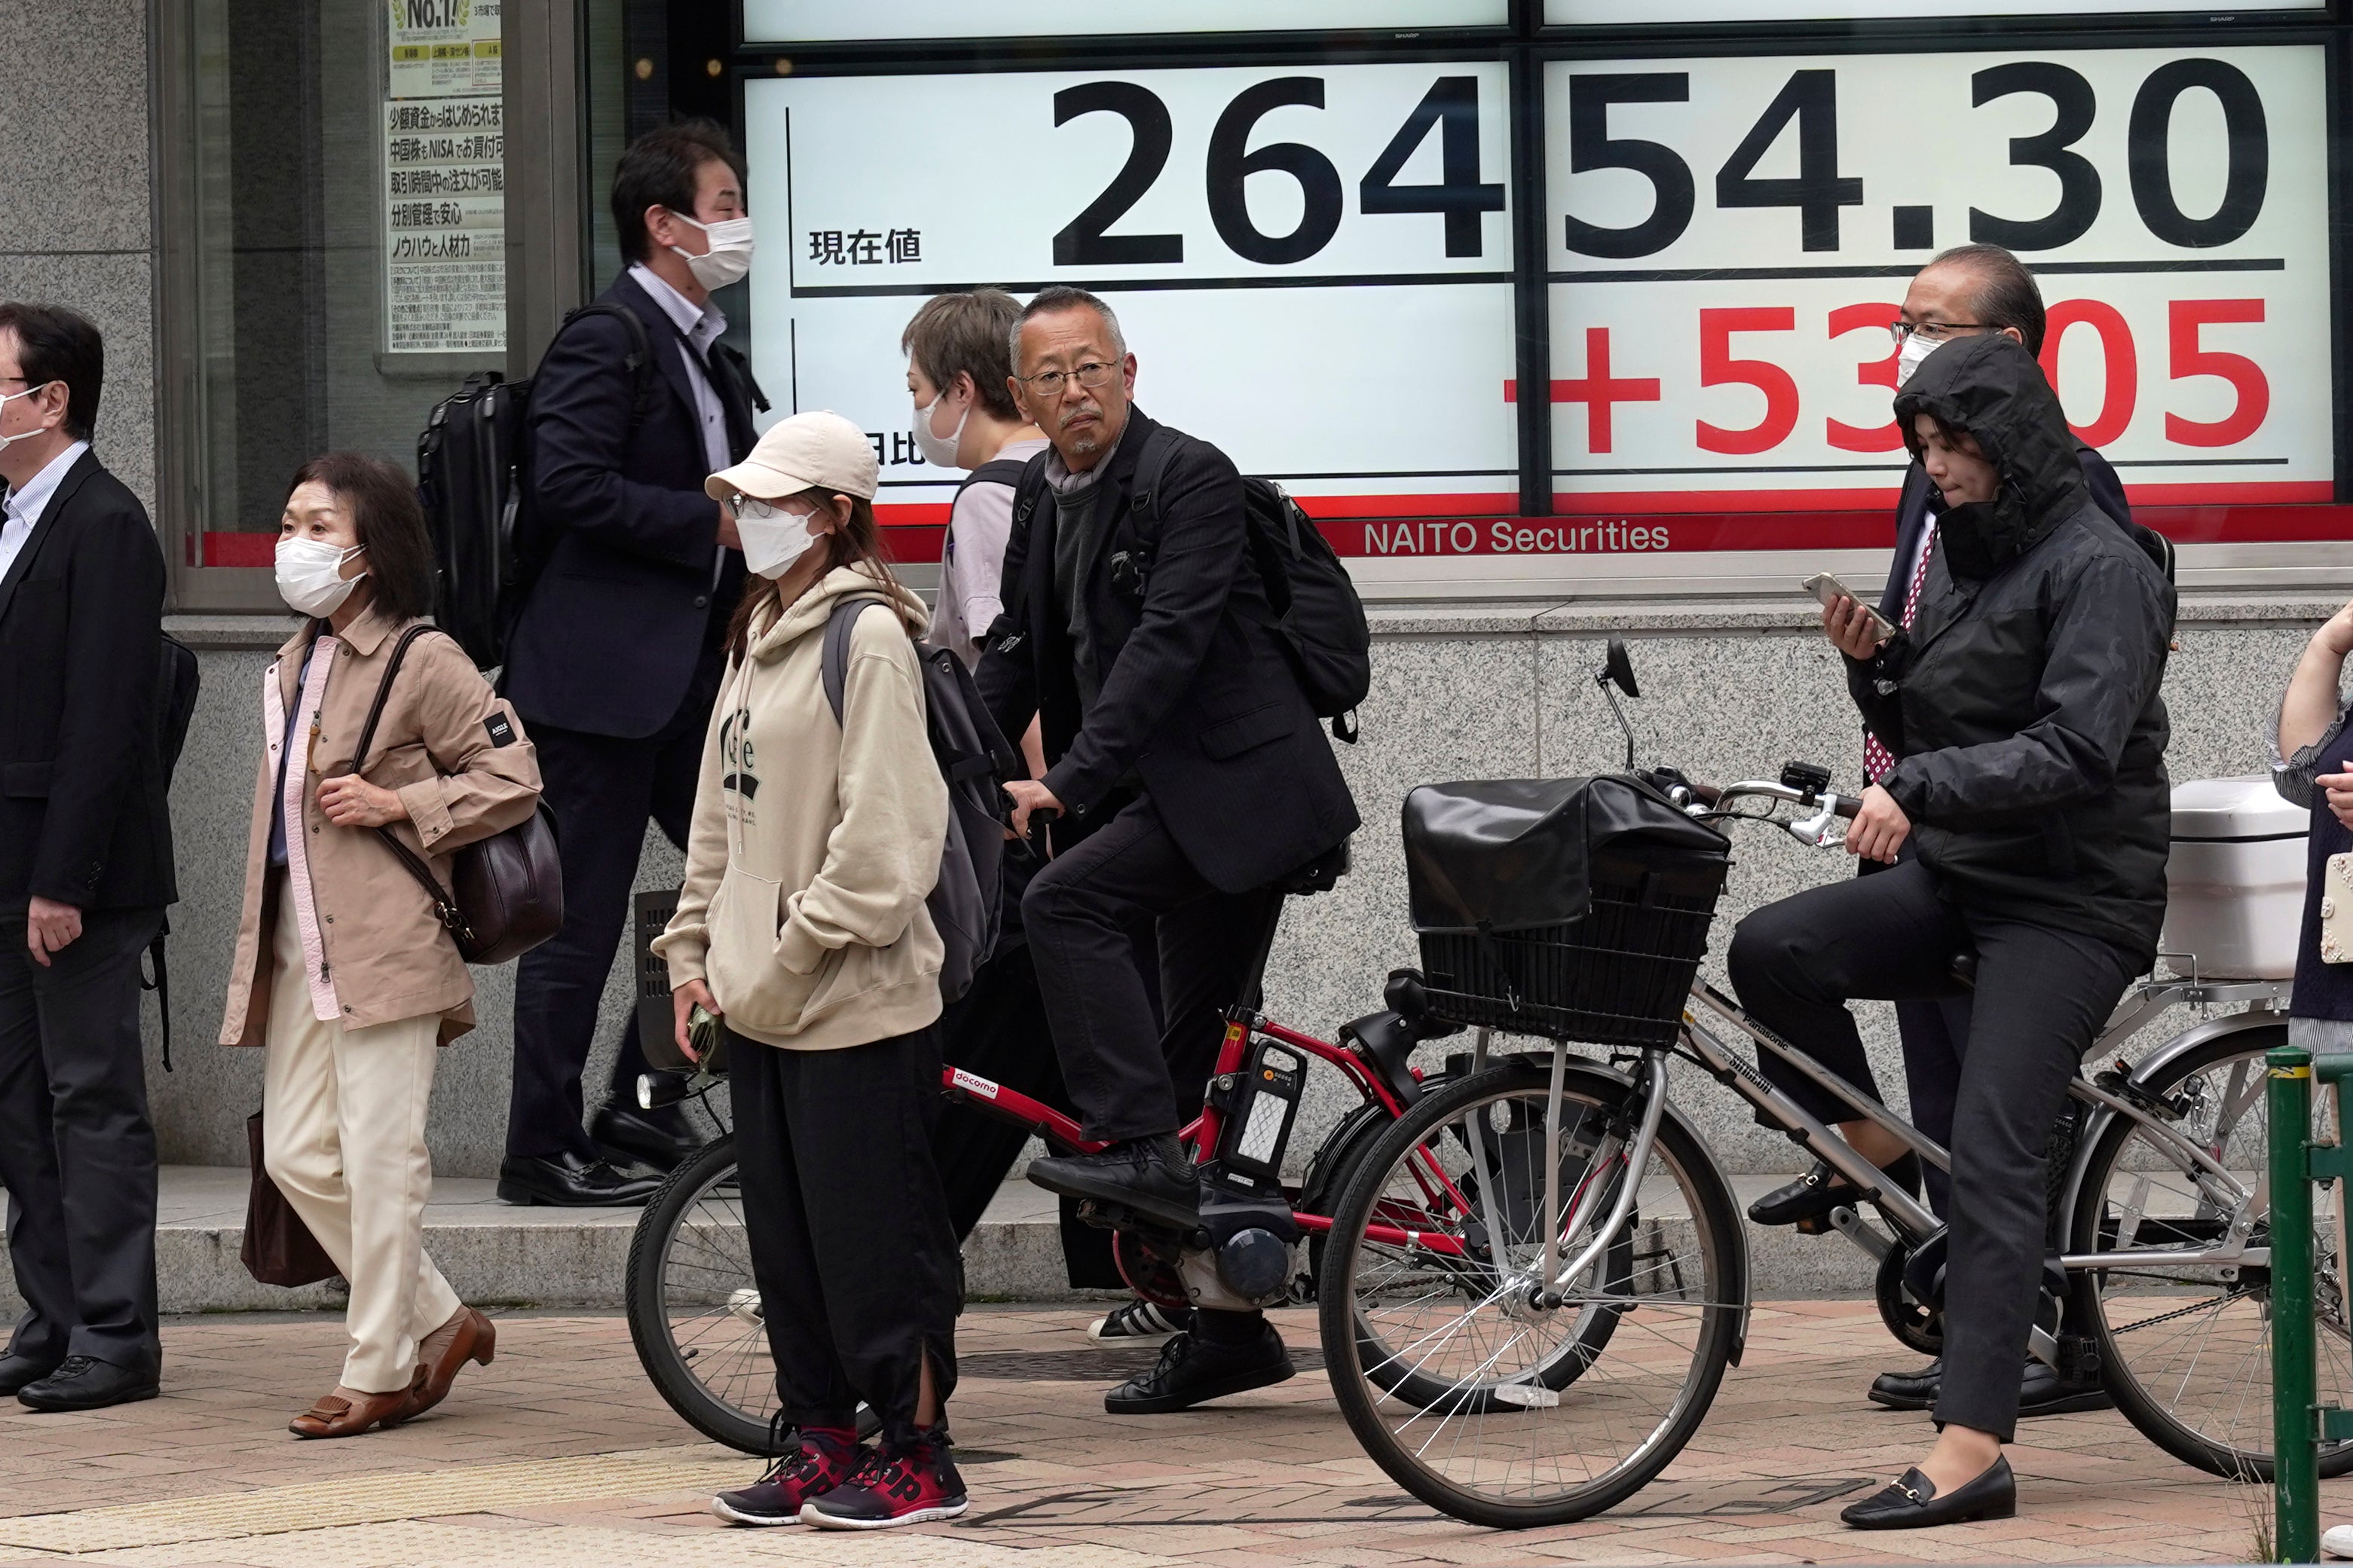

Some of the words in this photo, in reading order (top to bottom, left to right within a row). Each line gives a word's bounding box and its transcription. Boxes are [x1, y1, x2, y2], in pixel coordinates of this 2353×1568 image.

[389, 103, 503, 130] 少額資金からはじめられま
[391, 202, 462, 227] 分別管理で安心
[393, 234, 470, 258] ノウハウと人材力
[809, 228, 922, 265] 現在値
[1365, 522, 1477, 555] NAITO
[1490, 520, 1669, 552] Securities
[1743, 1014, 1788, 1050] Panasonic
[956, 1073, 996, 1093] docomo
